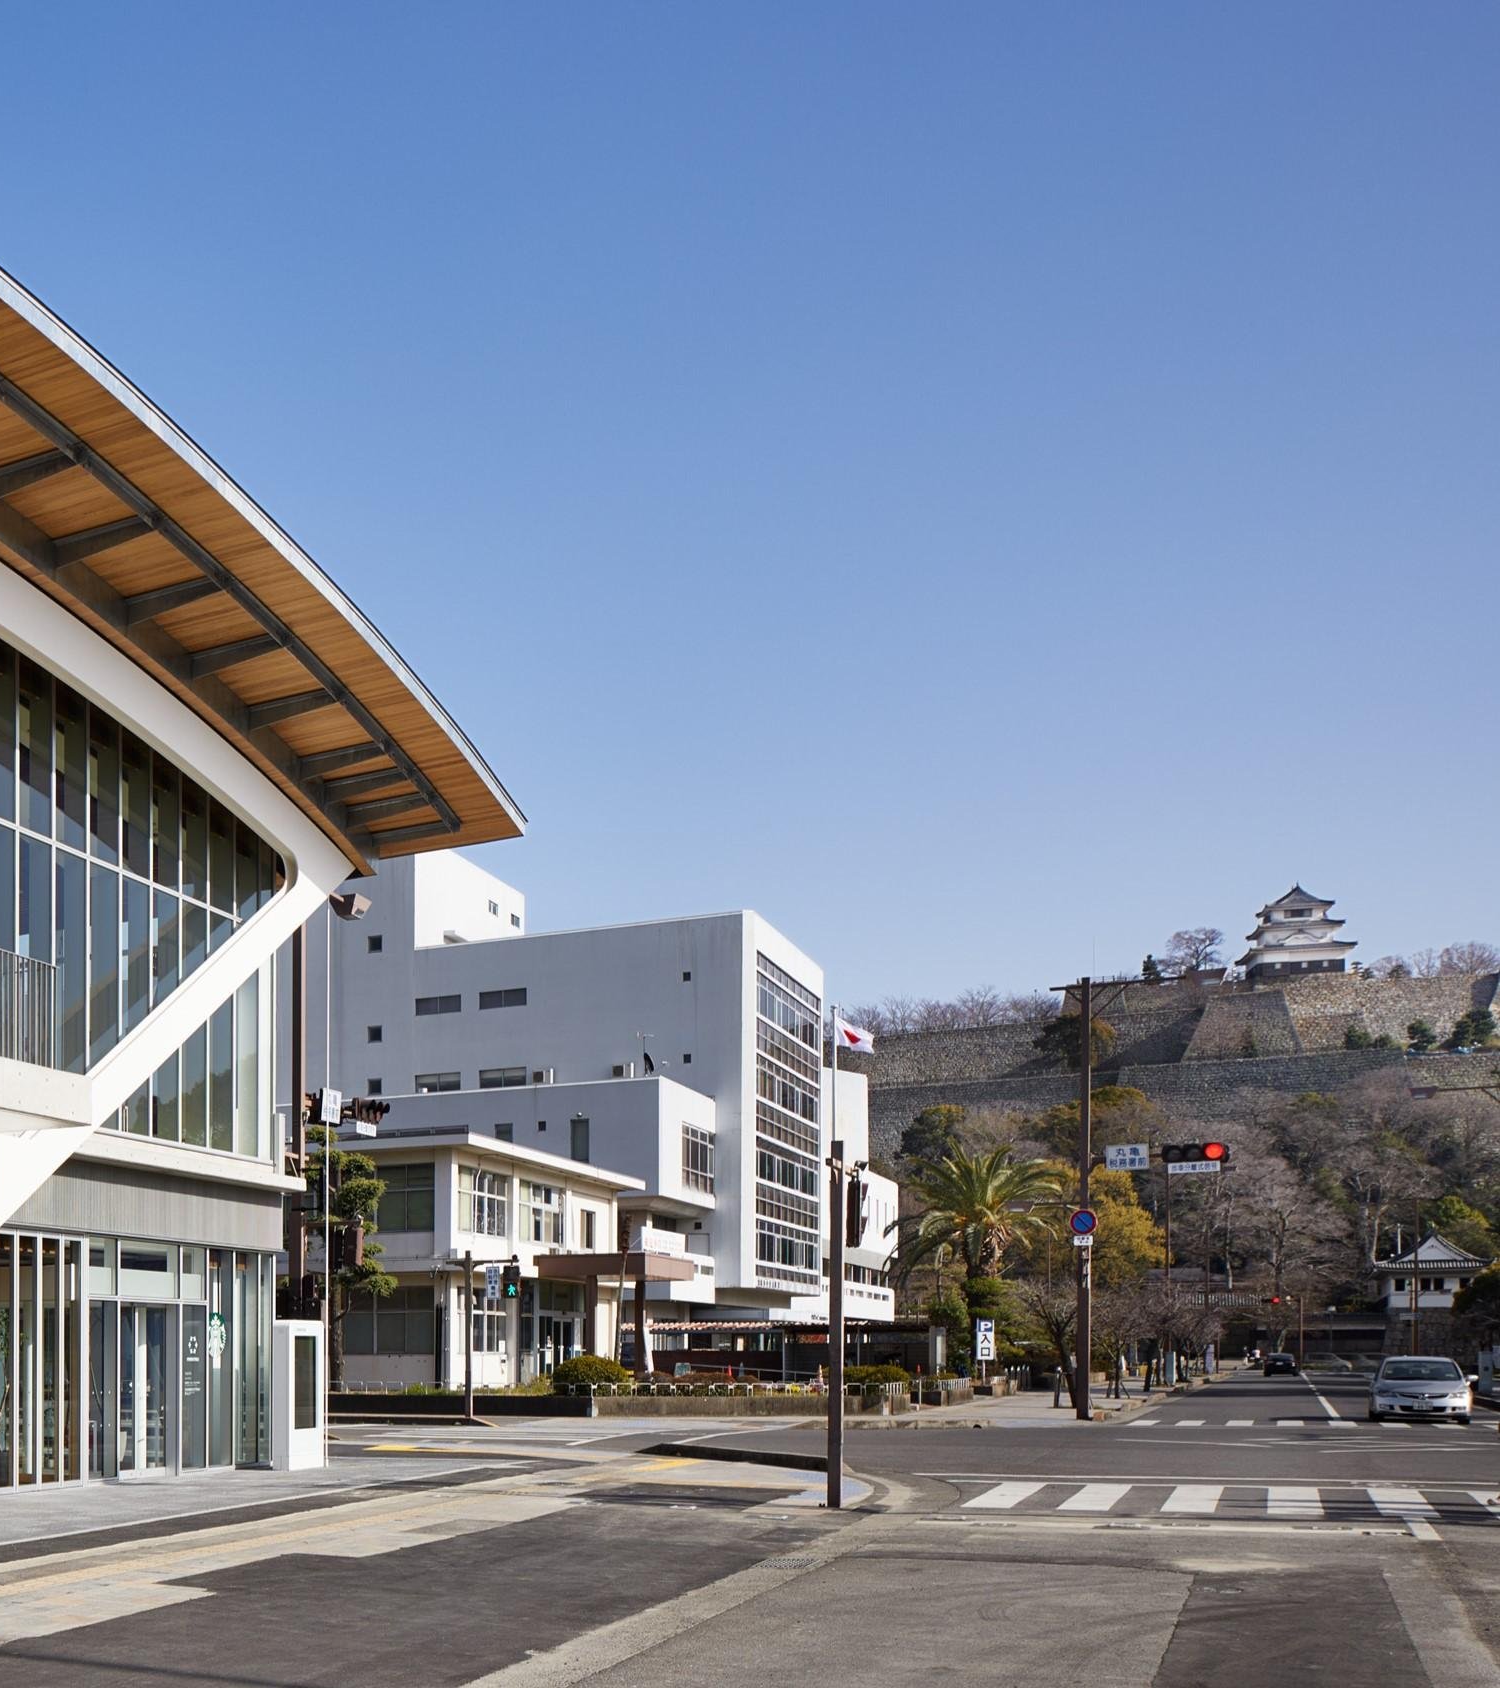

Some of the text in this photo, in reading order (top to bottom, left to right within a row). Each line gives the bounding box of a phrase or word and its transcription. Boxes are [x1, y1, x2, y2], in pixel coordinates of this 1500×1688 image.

[1116, 1147, 1140, 1157] 丸亀
[980, 1321, 992, 1332] P
[980, 1333, 991, 1357] 入口
